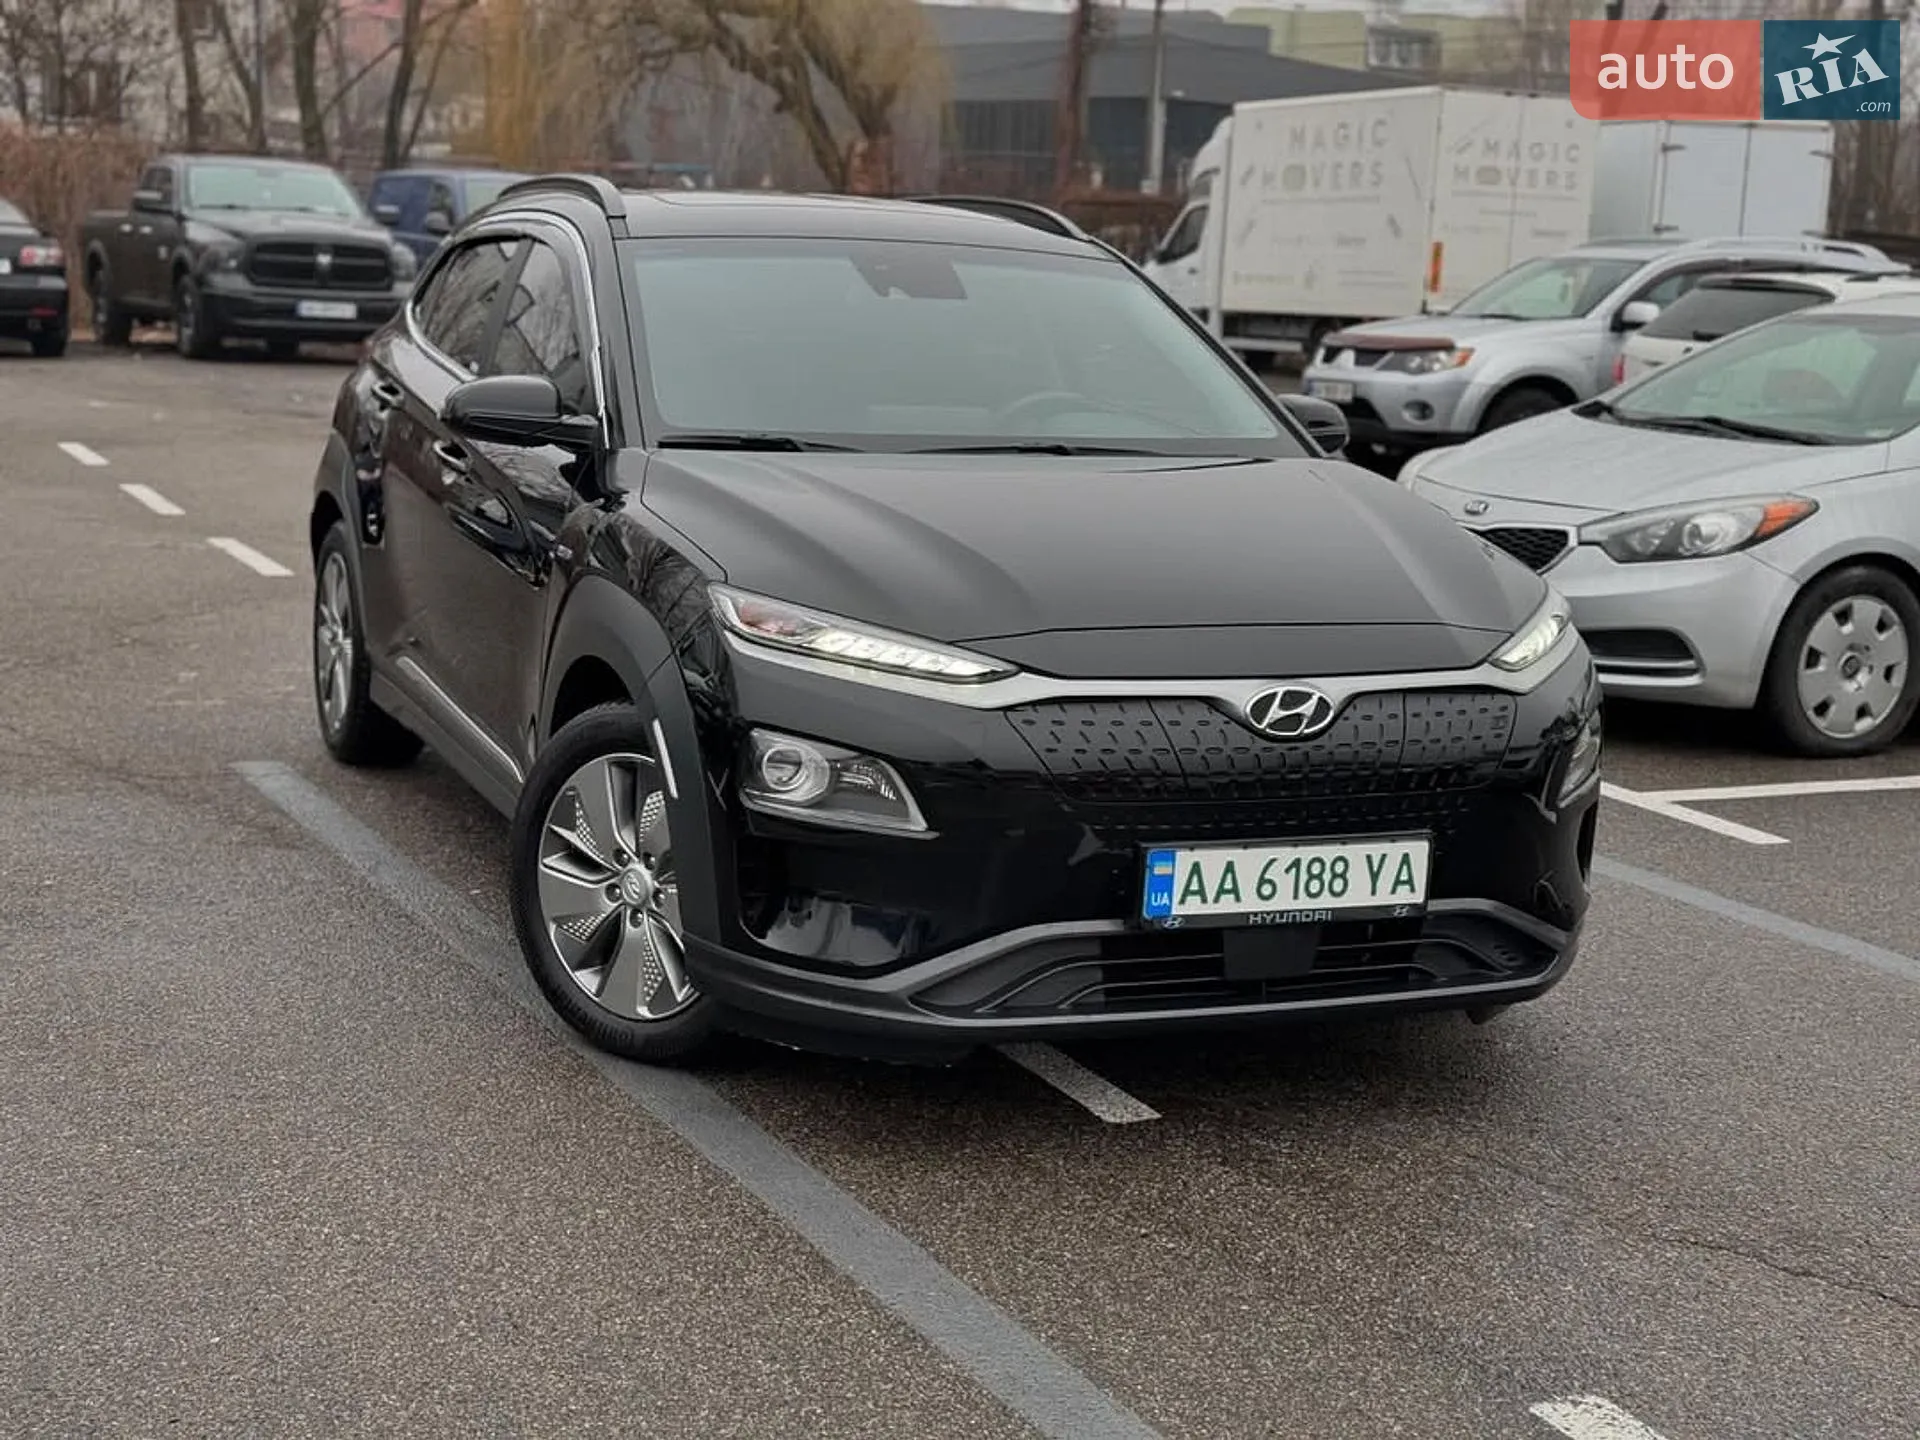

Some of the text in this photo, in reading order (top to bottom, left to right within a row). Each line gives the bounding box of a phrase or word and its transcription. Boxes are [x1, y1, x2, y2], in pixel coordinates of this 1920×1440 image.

[1289, 117, 1388, 151] MAGIC
[1482, 138, 1580, 164] MAGIC
[1178, 852, 1416, 905] AA 6188 YA
[1151, 892, 1170, 906] UA
[1249, 909, 1332, 925] HYUNDAI
